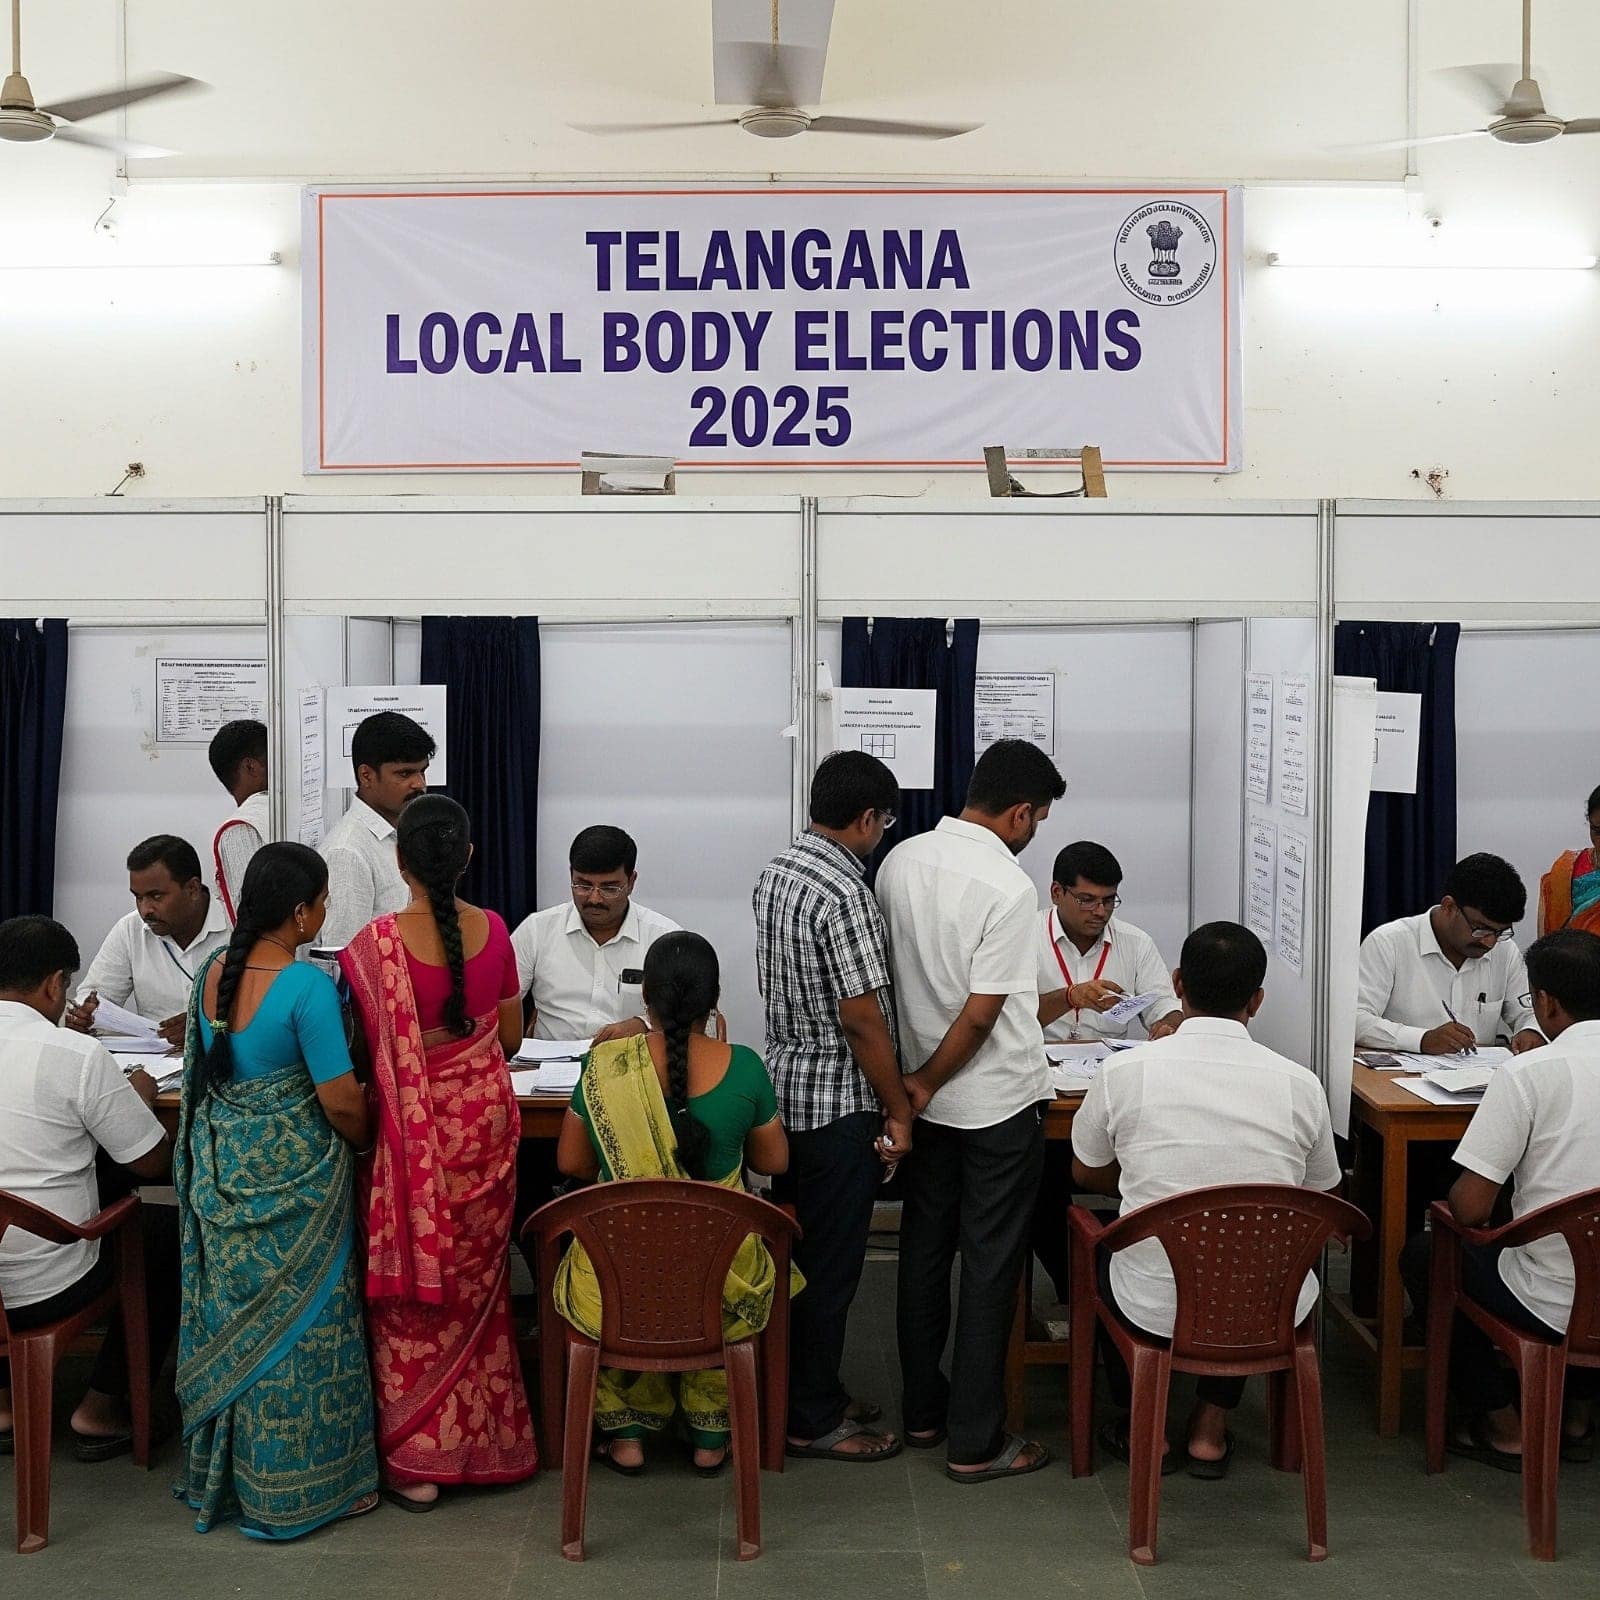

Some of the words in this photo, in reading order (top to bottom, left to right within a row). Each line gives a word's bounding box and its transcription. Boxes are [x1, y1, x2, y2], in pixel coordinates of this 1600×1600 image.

[586, 229, 969, 291] TELANGANA
[387, 312, 581, 374] LOCAL
[604, 310, 772, 373] BODY
[795, 309, 1141, 372] ELECTIONS
[689, 385, 851, 447] 2025
